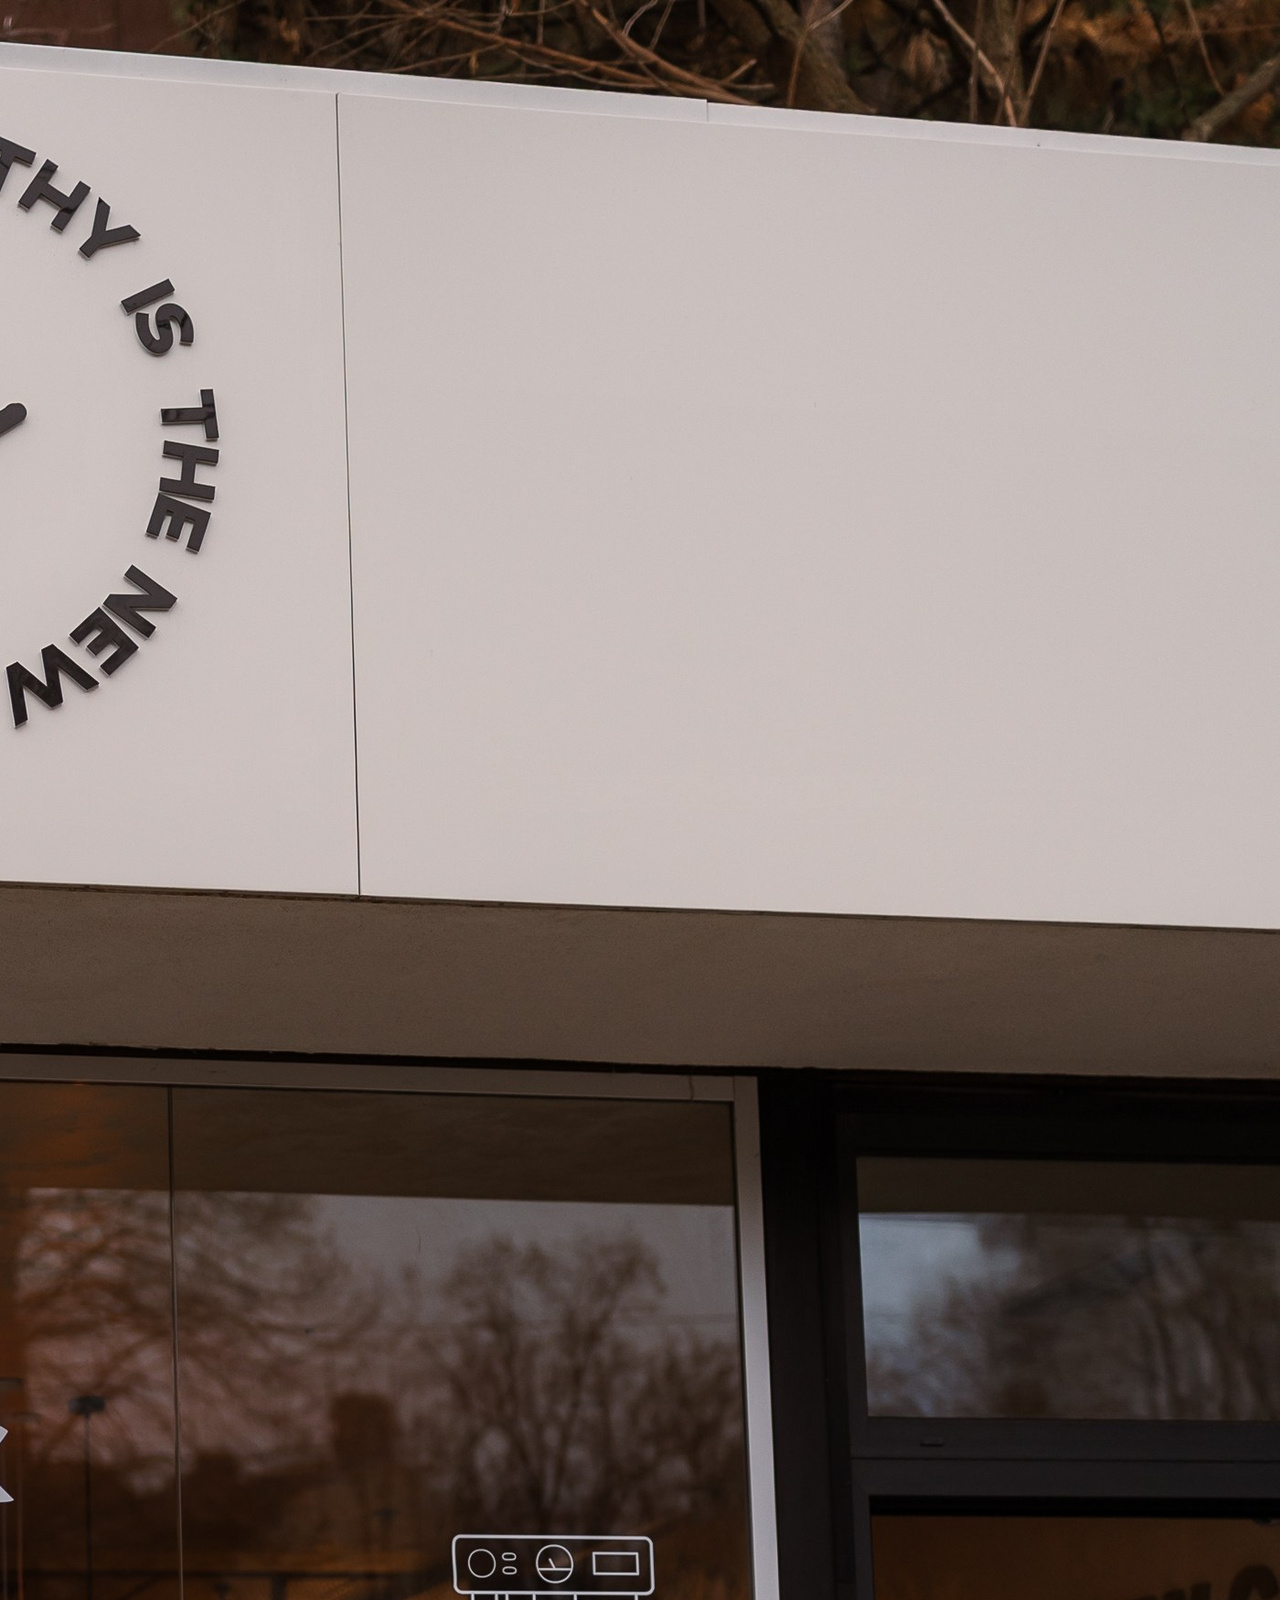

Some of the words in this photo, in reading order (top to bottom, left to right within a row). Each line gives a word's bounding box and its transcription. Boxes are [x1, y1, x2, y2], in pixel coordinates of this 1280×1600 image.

[121, 279, 195, 357] IS
[146, 389, 220, 554] THE
[6, 565, 178, 729] NEW
